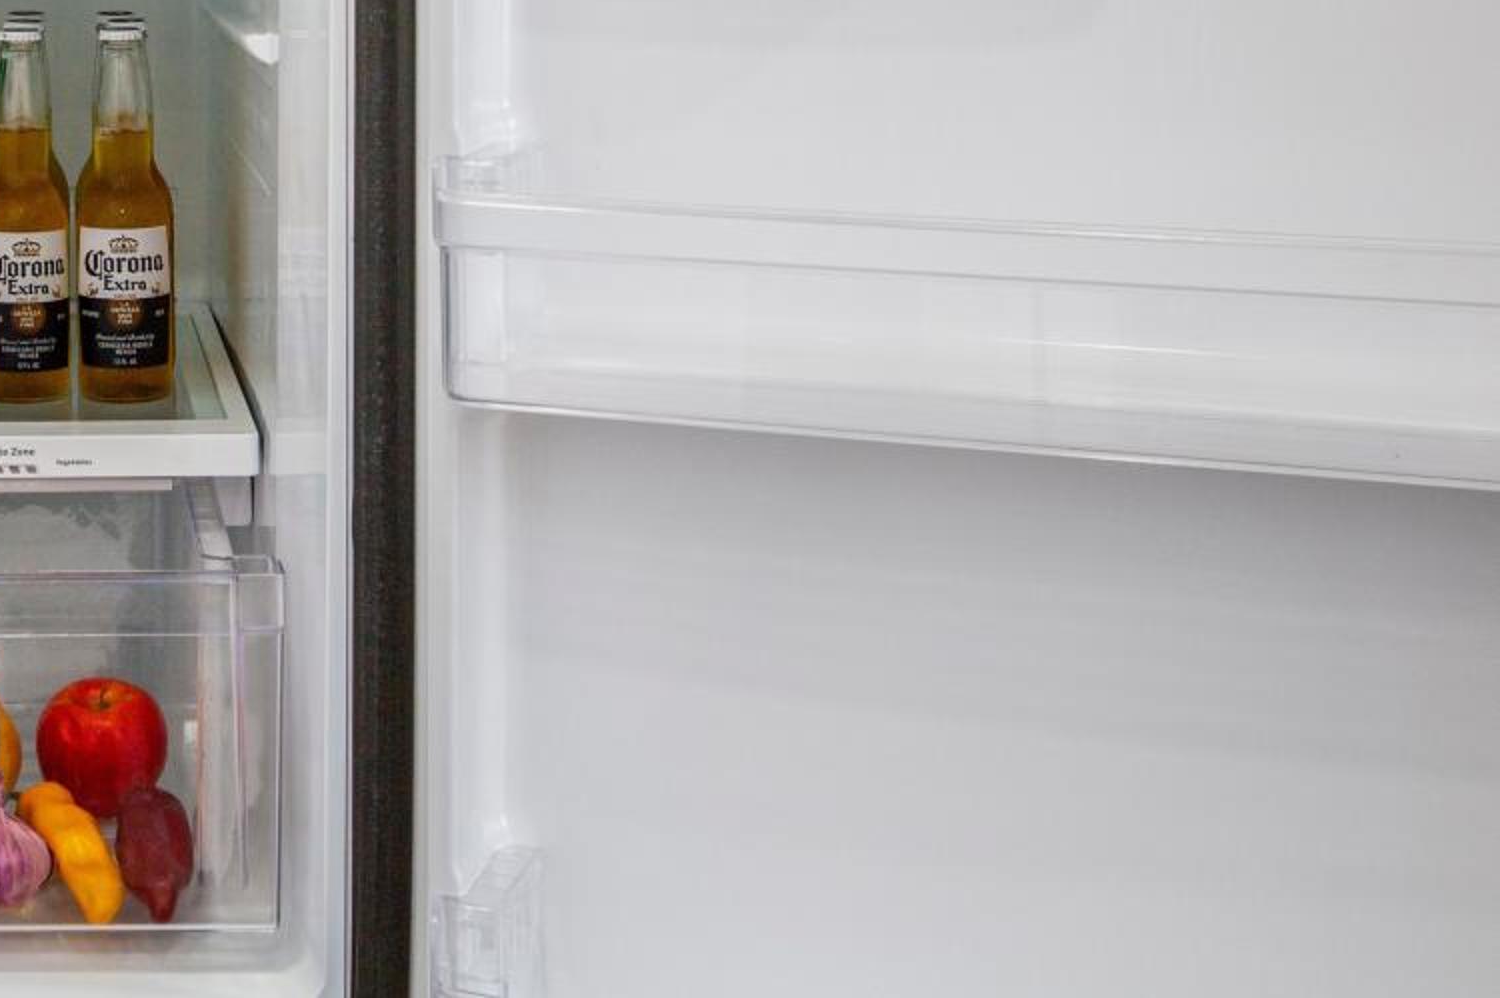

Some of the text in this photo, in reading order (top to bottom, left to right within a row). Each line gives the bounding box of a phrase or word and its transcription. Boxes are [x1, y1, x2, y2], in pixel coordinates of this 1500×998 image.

[85, 249, 165, 282] Corona
[7, 279, 50, 296] Extra
[103, 275, 147, 292] Extra
[11, 447, 36, 457] Zone
